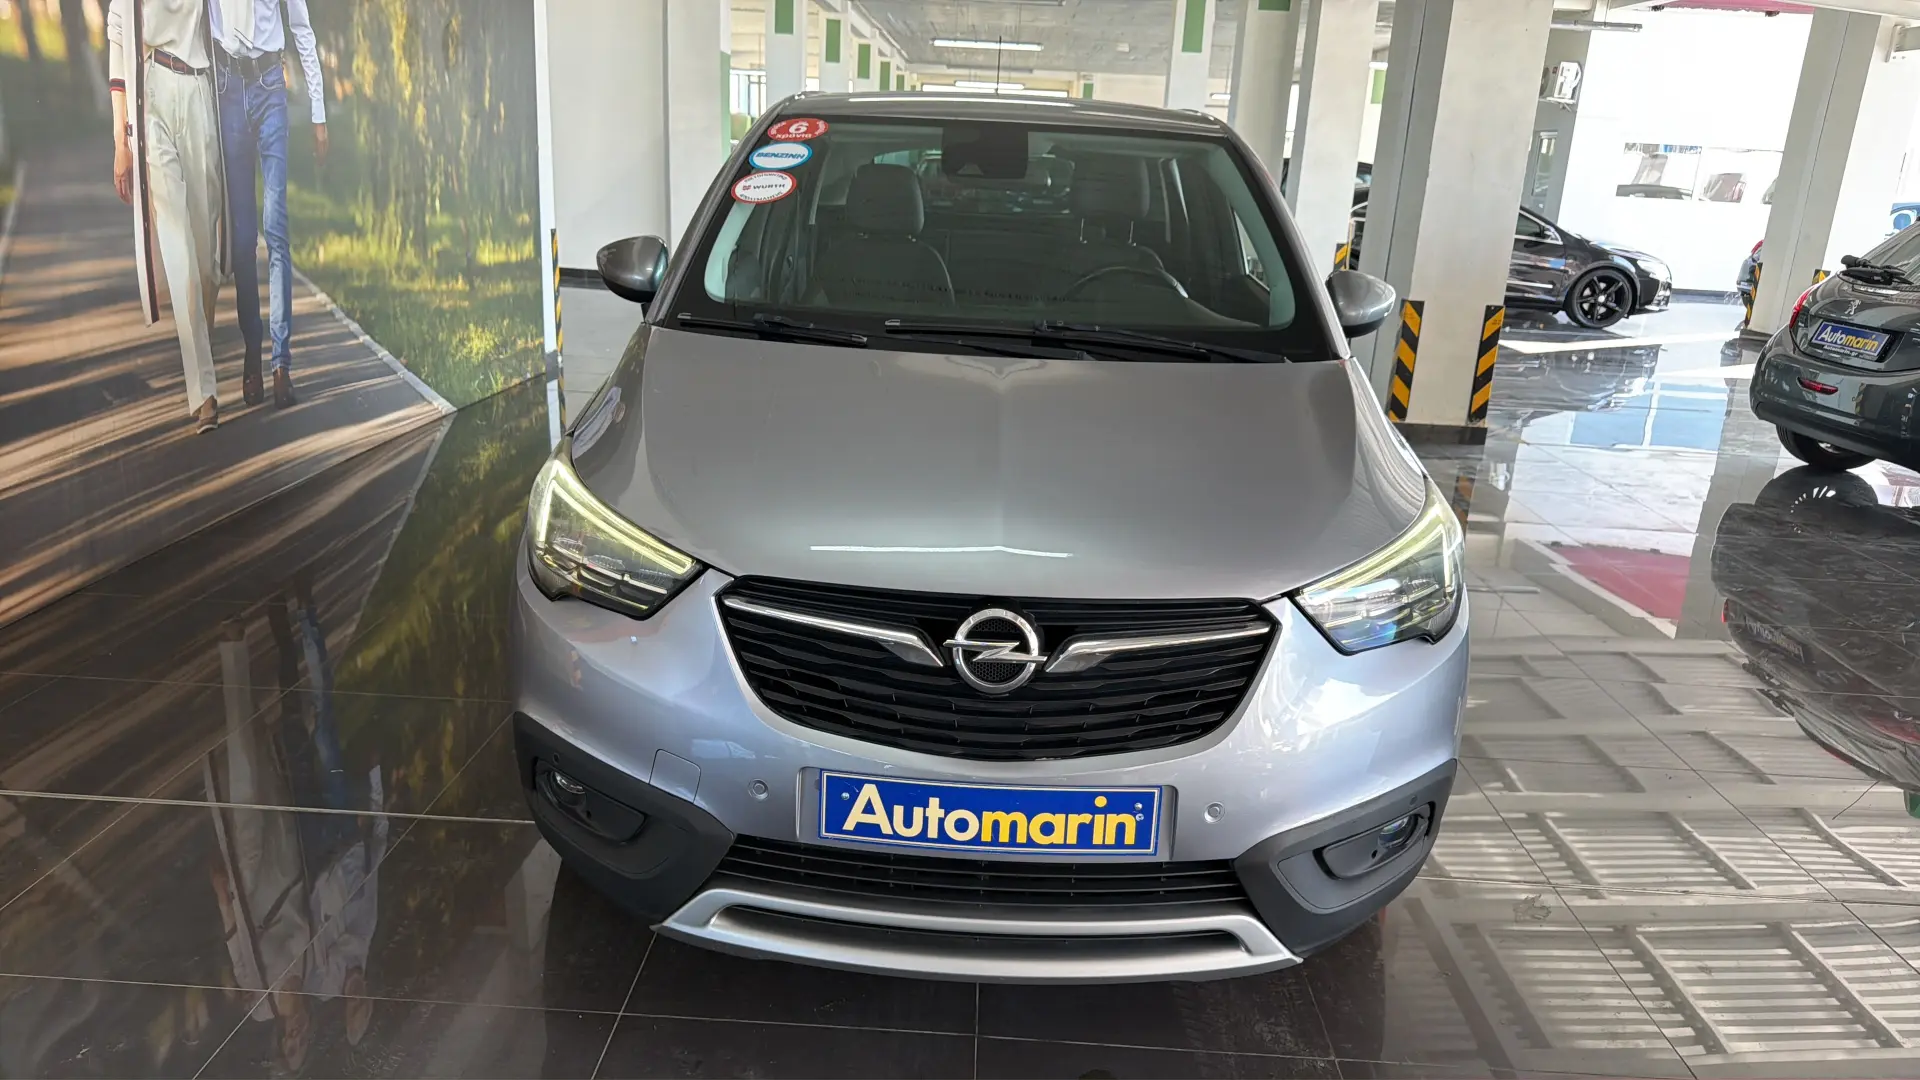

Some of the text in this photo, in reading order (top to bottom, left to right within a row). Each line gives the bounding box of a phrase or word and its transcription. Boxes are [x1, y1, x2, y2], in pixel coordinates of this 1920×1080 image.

[789, 121, 809, 133] 6
[1818, 326, 1879, 351] Automarin
[842, 783, 1137, 845] Automarin
